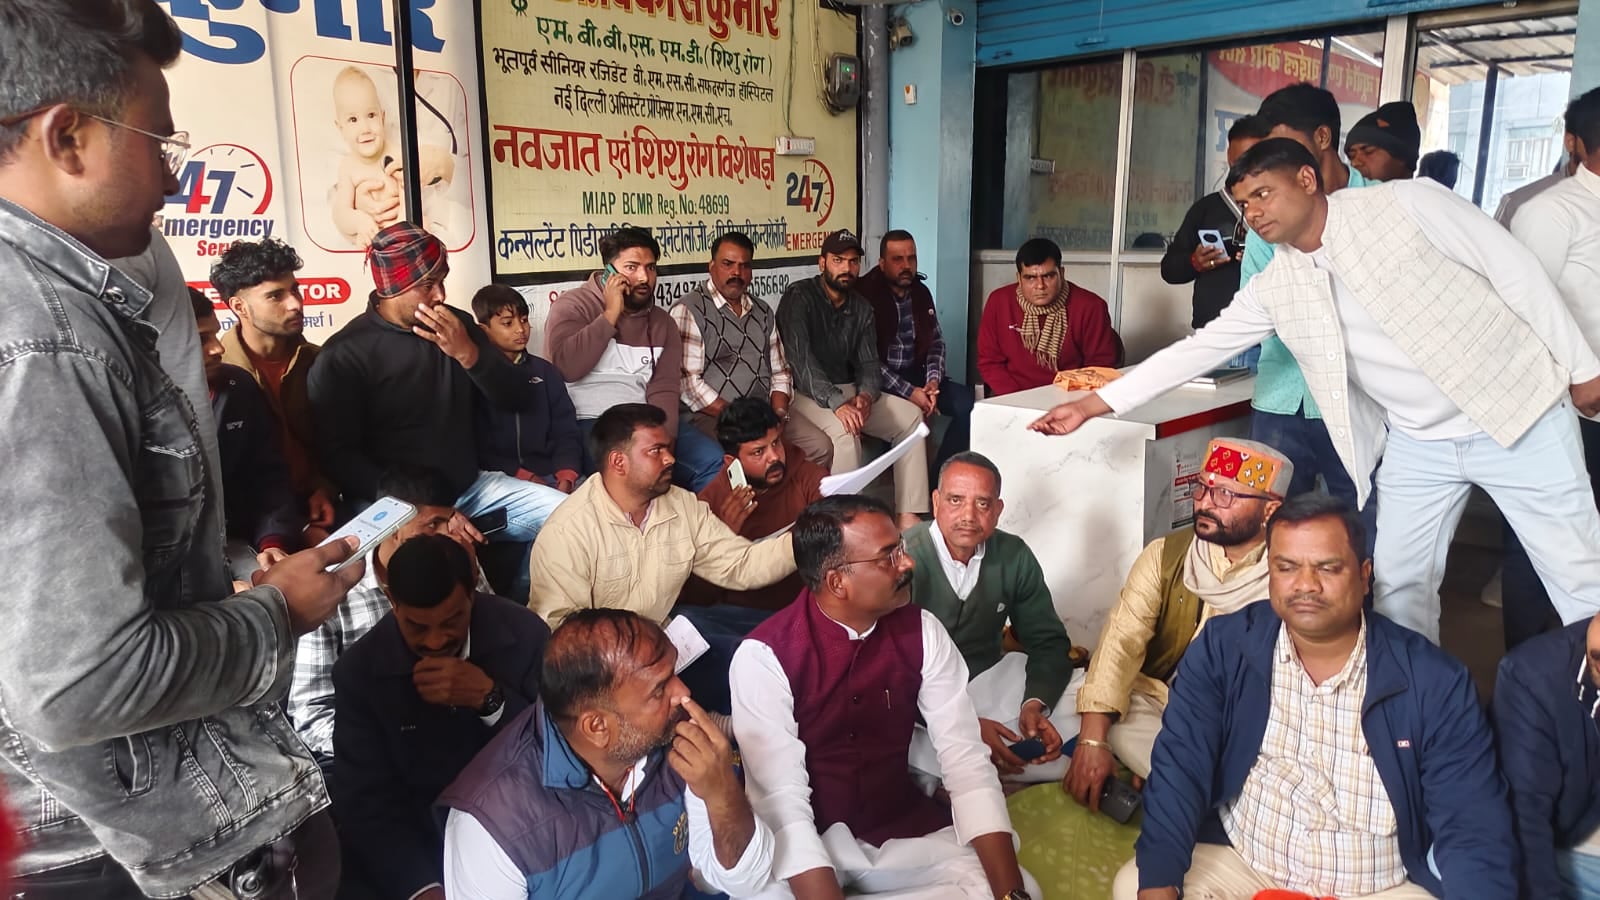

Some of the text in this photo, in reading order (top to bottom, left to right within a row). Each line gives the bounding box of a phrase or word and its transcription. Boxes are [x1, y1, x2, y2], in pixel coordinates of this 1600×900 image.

[493, 47, 537, 77] भूतपूर्व
[540, 50, 587, 79] सीनियर
[554, 86, 574, 118] नई
[575, 85, 607, 118] दिल्ली
[493, 125, 602, 175] नवजात
[606, 130, 632, 180] एवं
[714, 135, 775, 190] विशेषज्ञ
[165, 161, 236, 214] 47
[583, 191, 730, 218] MIAP BCMR Reg. No: 48699
[164, 218, 274, 239] mergency
[786, 231, 834, 251] EMERGEN
[300, 283, 342, 300] TOR
